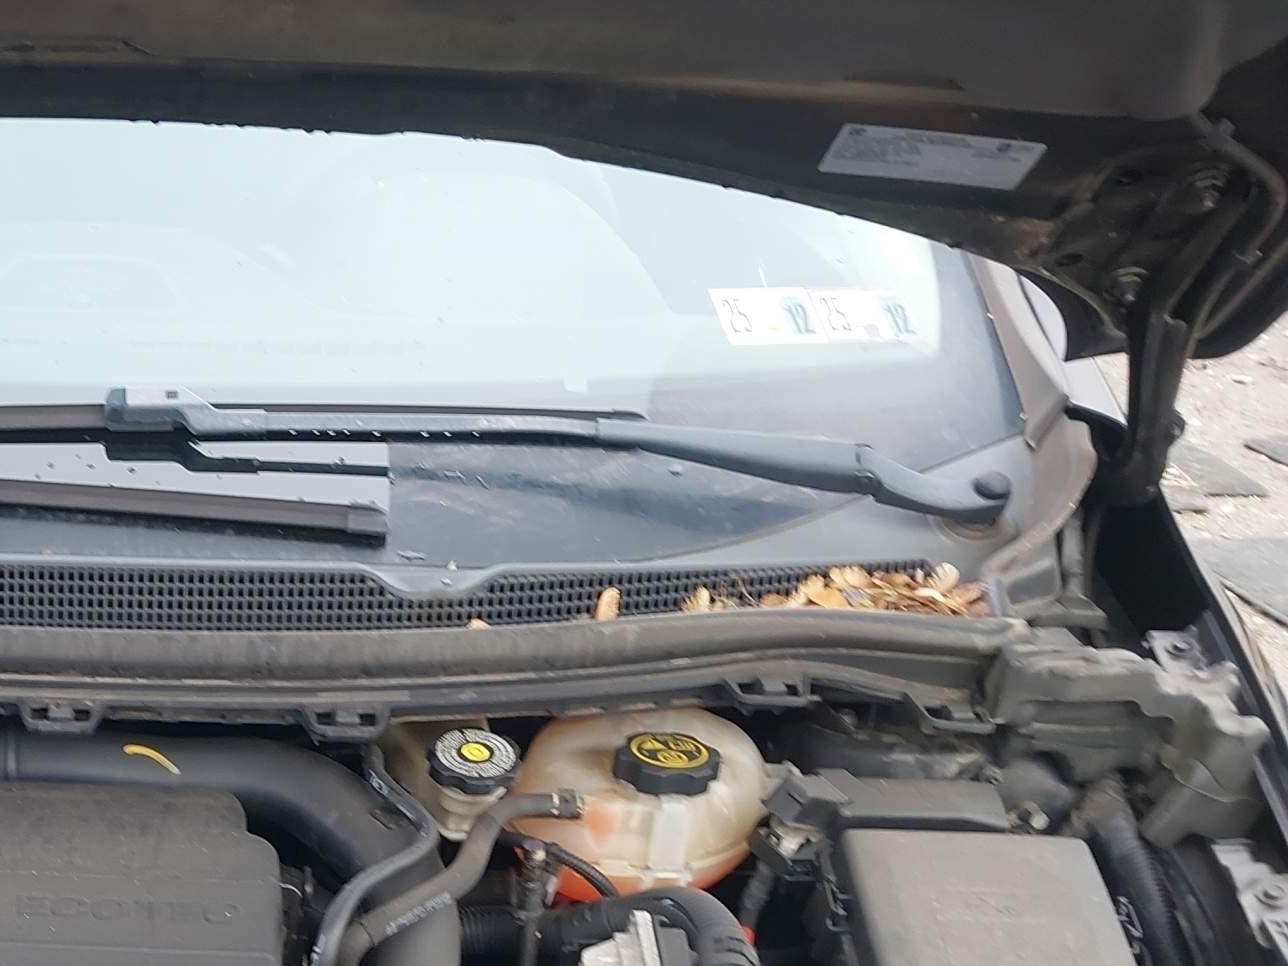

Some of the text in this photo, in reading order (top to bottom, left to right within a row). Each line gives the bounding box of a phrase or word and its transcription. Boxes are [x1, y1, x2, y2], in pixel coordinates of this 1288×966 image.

[722, 298, 816, 335] 25 12
[819, 297, 918, 335] 25 12
